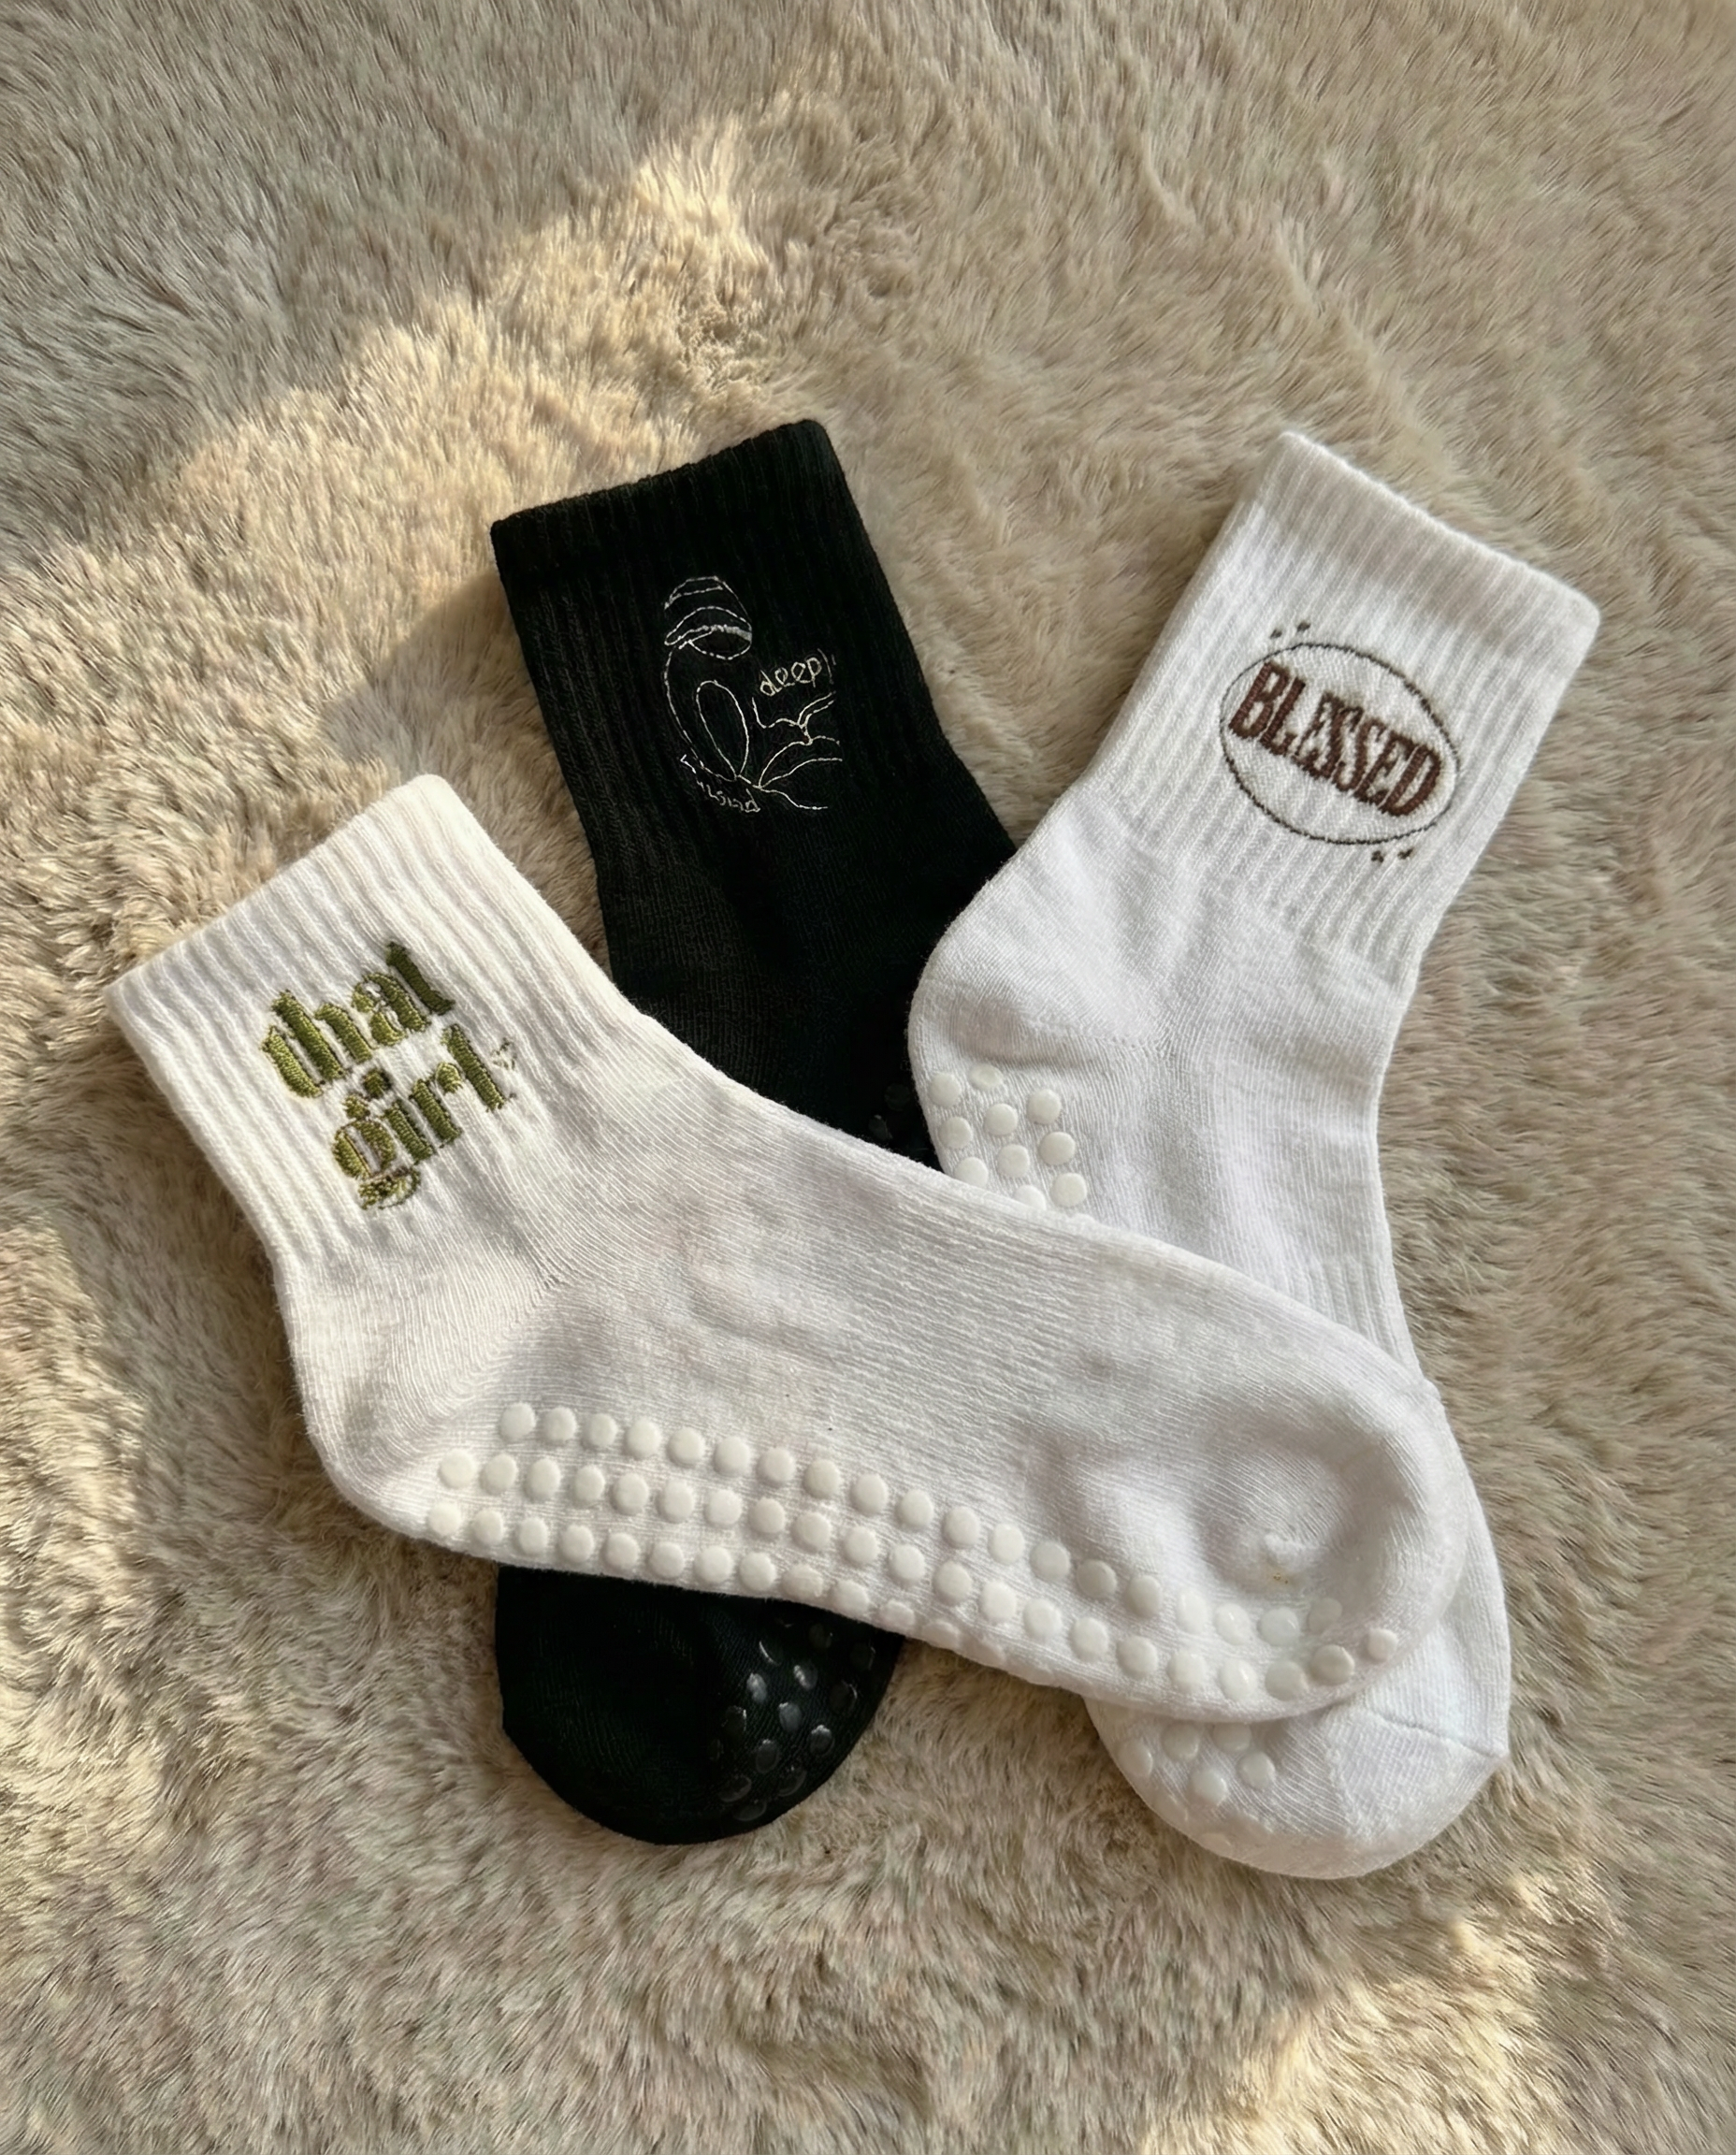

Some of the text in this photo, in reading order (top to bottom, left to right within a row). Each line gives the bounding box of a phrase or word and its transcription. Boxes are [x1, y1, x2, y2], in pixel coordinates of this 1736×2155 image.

[1228, 660, 1441, 817] BLESSED
[259, 940, 456, 1098] that
[332, 1023, 505, 1209] girl
